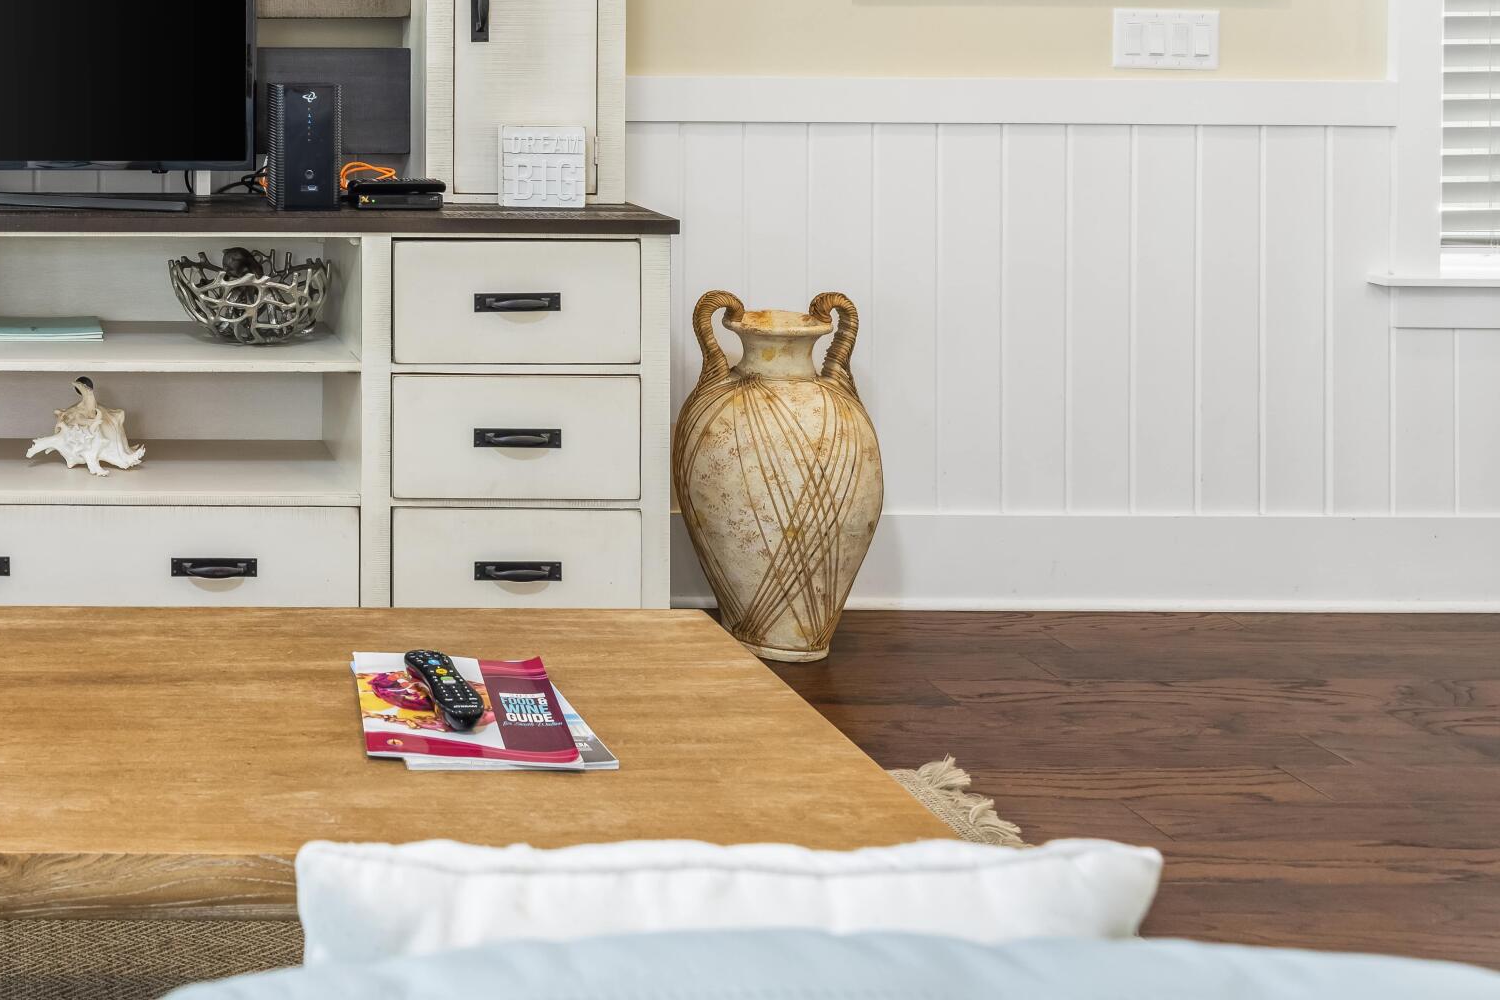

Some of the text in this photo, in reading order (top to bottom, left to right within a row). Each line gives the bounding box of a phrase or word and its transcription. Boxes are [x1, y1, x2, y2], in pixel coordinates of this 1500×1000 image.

[512, 135, 580, 154] DREAM
[512, 159, 577, 202] BIG
[500, 696, 548, 705] FOOD &
[502, 704, 551, 714] WINE
[505, 712, 555, 723] GUIDE
